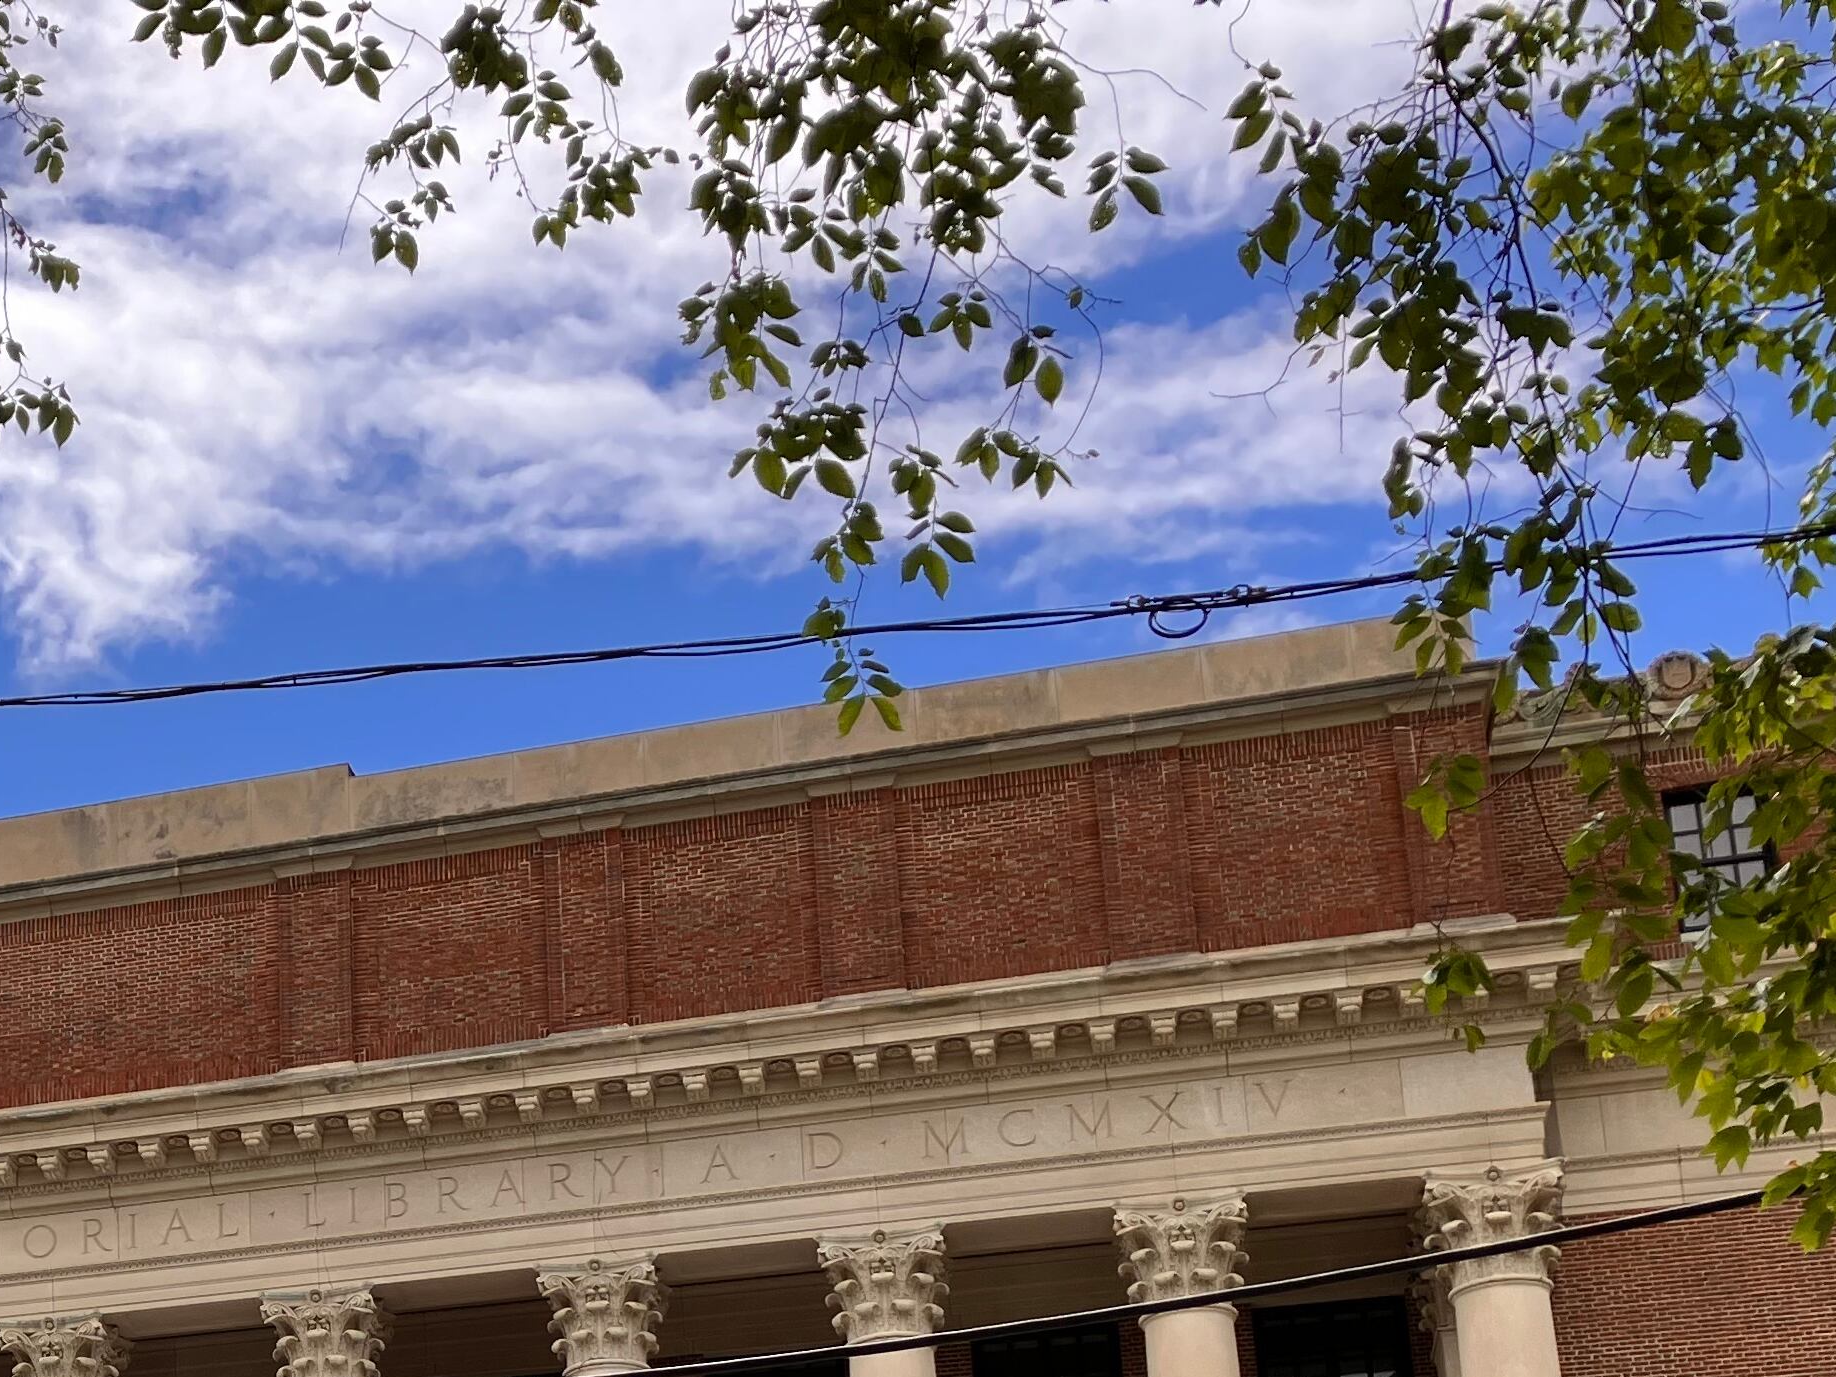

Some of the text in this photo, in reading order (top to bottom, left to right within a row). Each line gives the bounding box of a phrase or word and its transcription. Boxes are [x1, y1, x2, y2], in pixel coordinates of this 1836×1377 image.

[302, 1154, 632, 1229] LIBRARY
[700, 1143, 741, 1185] A
[807, 1131, 846, 1171] D
[920, 1078, 1295, 1160] MCMXIV
